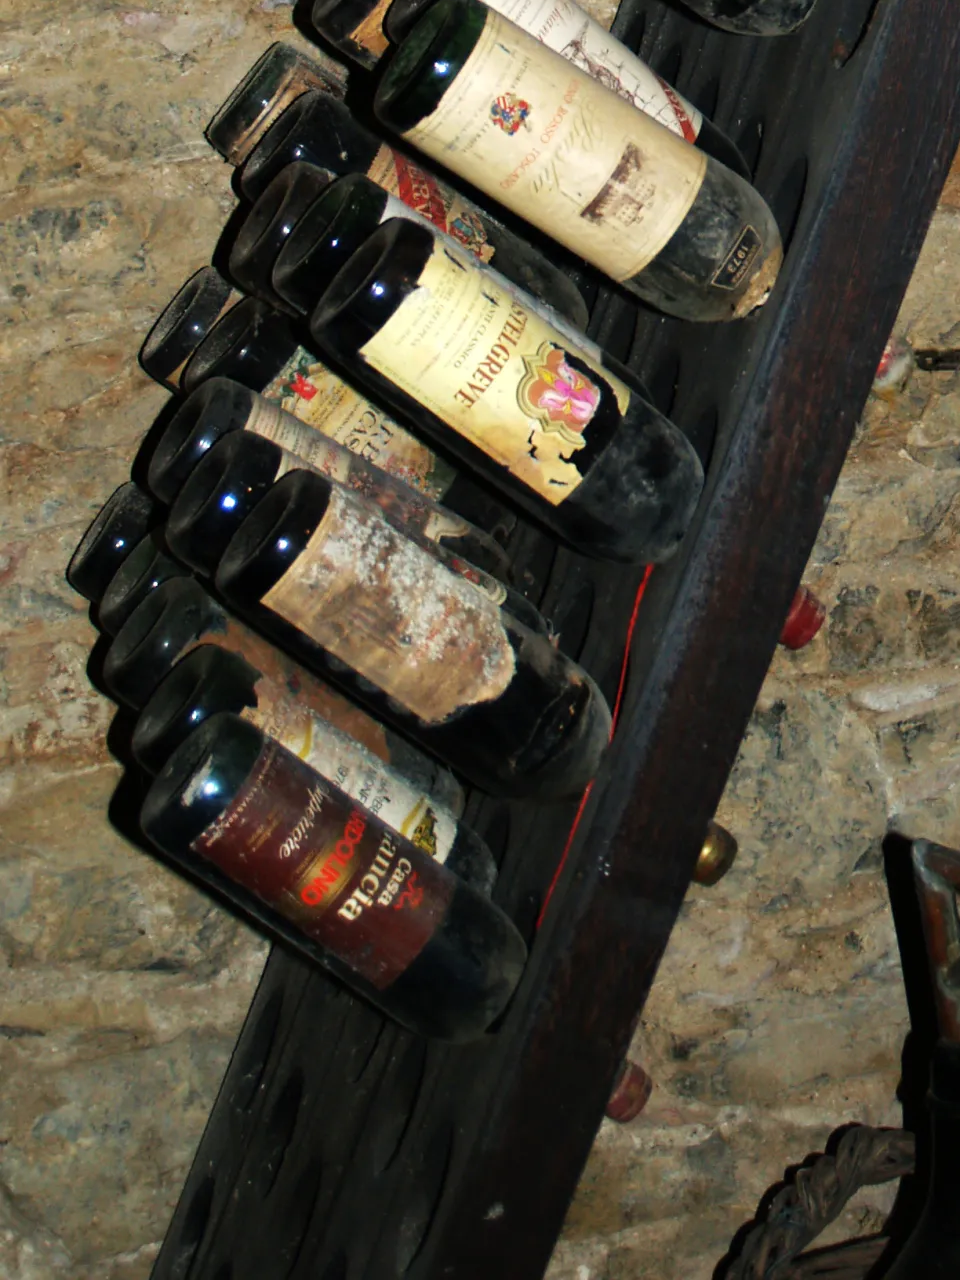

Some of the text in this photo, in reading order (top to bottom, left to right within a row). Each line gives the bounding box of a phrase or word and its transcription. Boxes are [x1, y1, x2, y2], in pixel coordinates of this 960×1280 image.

[538, 105, 568, 144] ROSSO
[498, 147, 541, 189] TOSCANO
[725, 243, 749, 274] 1973
[452, 324, 486, 369] CLASSICO
[279, 781, 331, 859] Superiore
[376, 858, 410, 907] Casa
